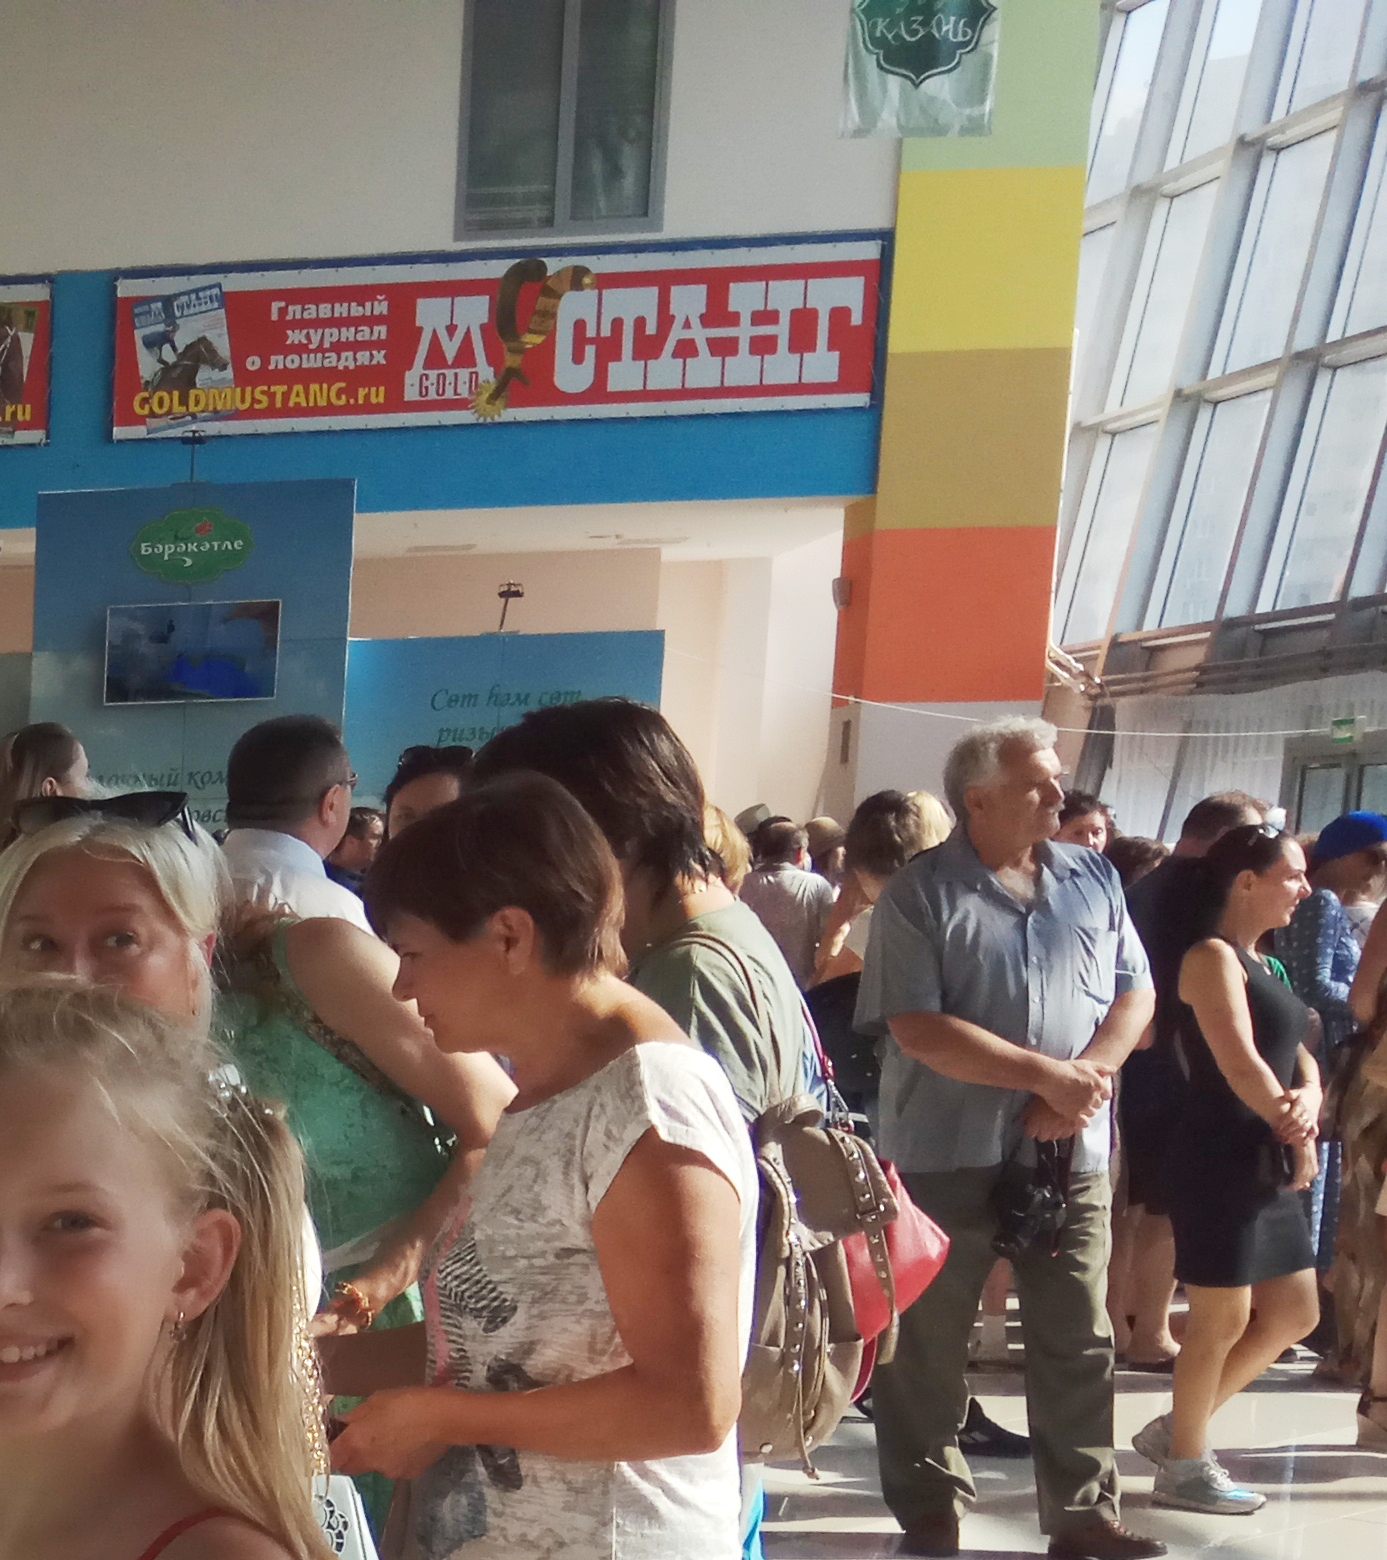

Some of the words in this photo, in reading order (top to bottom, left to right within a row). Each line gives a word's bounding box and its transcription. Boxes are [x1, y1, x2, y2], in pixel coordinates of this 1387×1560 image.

[270, 294, 390, 322] Главный
[284, 321, 388, 347] журнал
[245, 353, 261, 371] о
[266, 346, 388, 372] лошадях
[132, 381, 387, 418] GOLDMUSTANG.ru
